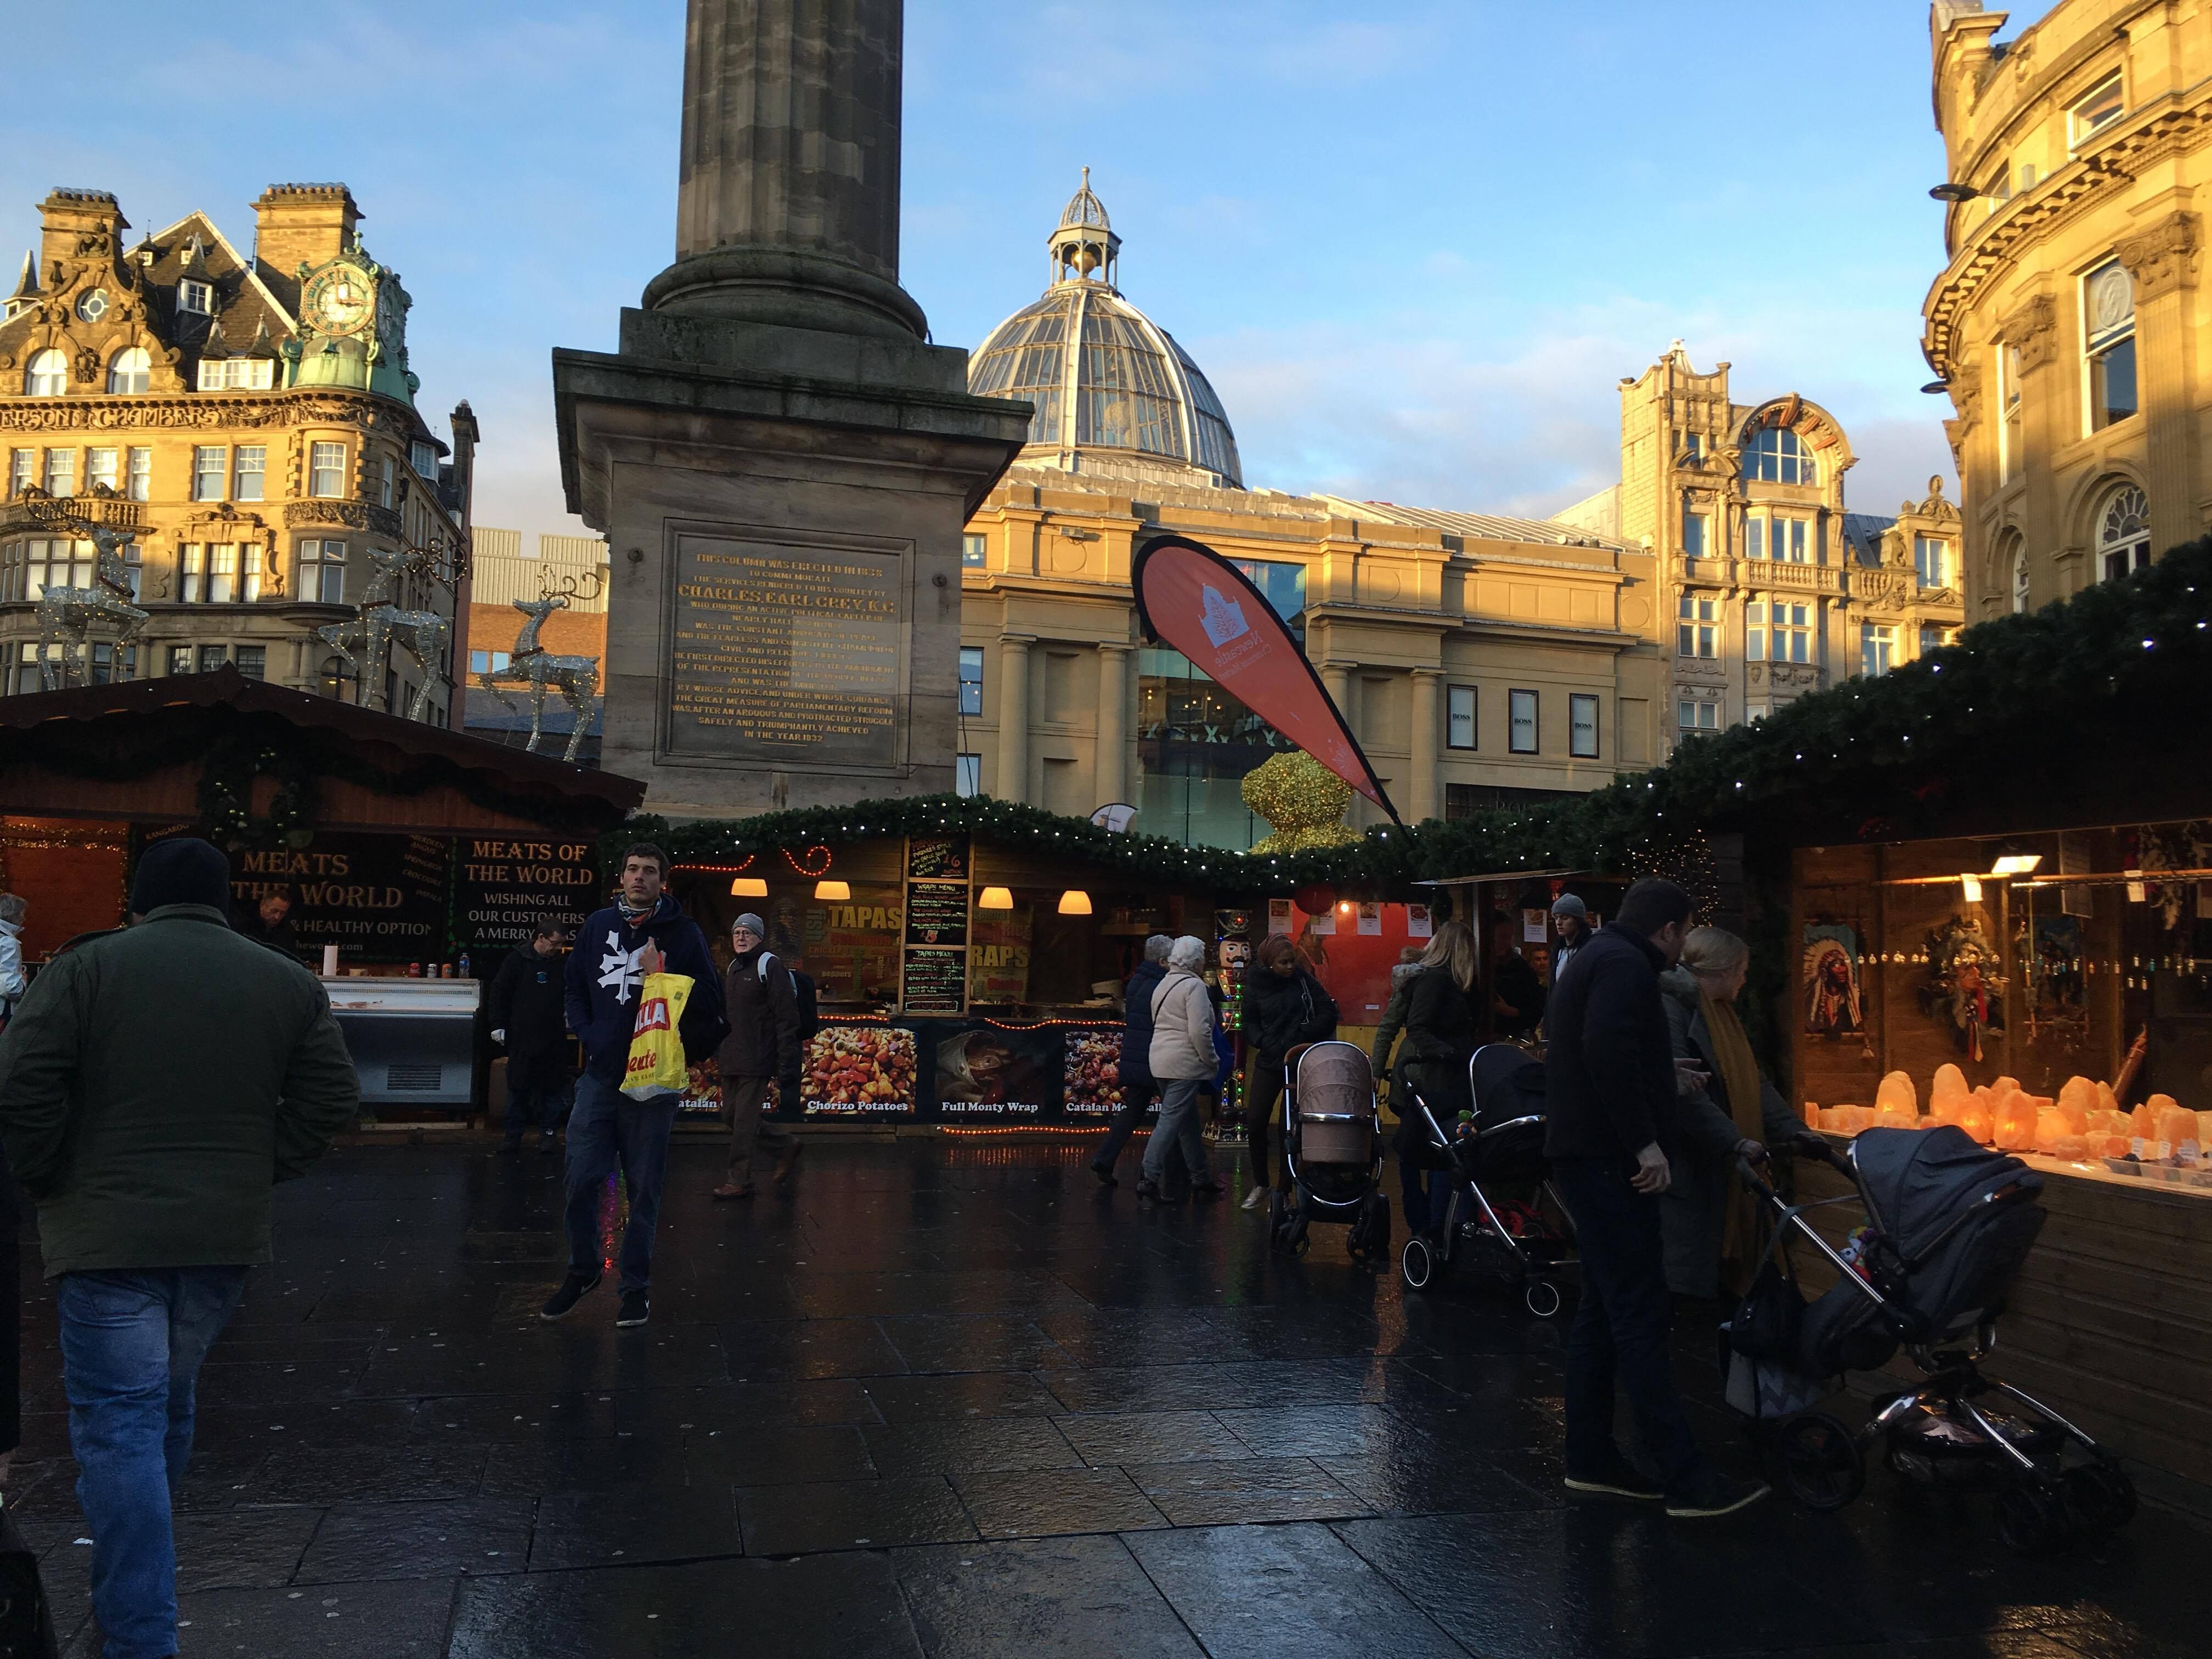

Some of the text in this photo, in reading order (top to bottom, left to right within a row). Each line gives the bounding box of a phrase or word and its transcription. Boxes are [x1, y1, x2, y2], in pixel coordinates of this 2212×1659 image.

[95, 408, 218, 428] CHAMBERS
[696, 553, 720, 563] THIS
[722, 555, 766, 567] COLUMN
[768, 559, 790, 569] WAS
[791, 561, 842, 573] ERECTED
[844, 566, 855, 574] IN
[714, 577, 755, 586] SERVICES
[757, 580, 802, 590] RENDERED
[834, 586, 872, 596] COUNTRY
[765, 590, 813, 607] EARL
[712, 602, 744, 612] DURING
[760, 606, 789, 615] ACTIVE
[791, 608, 834, 618] POLITICAL
[838, 612, 872, 621] CAREER
[732, 614, 768, 624] NEARLY
[695, 622, 714, 630] WAS
[737, 625, 783, 635] CONSTANT
[676, 631, 693, 639] AND
[713, 634, 758, 644] FEARLESS
[720, 645, 744, 653] CIVIL
[687, 652, 712, 661] FIRST
[714, 654, 757, 664] DIRECTED
[693, 663, 710, 672] THE
[712, 664, 790, 677] REPRESENTATION
[752, 678, 771, 686] WAS
[693, 685, 724, 694] WHOSE
[782, 691, 811, 699] UNDER
[814, 693, 844, 702] WHOSE
[847, 696, 889, 705] GUIDANCE
[675, 694, 692, 702] THE
[695, 696, 723, 704] GREAT
[726, 697, 767, 707] MEASURE
[783, 701, 856, 713] PARLIAMENTARY
[858, 706, 893, 715] REFORM
[693, 705, 721, 714] AFTER
[736, 708, 777, 718] ARDUOUS
[778, 711, 795, 719] AND
[798, 713, 851, 723] PROTRACTED
[854, 716, 894, 726] STRUGGLE
[698, 716, 869, 735] SAFELY AND TRIUMPHANTLY ACHIEVED
[777, 732, 800, 741] YEAR
[472, 840, 588, 862] MEATS OF
[241, 851, 351, 876] MEATS
[465, 863, 593, 885] THE WORLD
[300, 880, 404, 909] WORLD
[484, 893, 571, 906] WISHING ALL
[469, 910, 499, 922] OUR
[828, 905, 901, 930] TAPAS
[304, 920, 374, 934] HEALTHY
[475, 927, 535, 939] A MERRY
[970, 945, 1029, 968] RAPS
[634, 1002, 666, 1033] ILLA
[679, 1099, 717, 1108] atalan
[807, 1101, 909, 1110] Chorizo Potatoes
[941, 1102, 1039, 1113] Full Monty Wrap
[1066, 1102, 1109, 1111] Catalan
